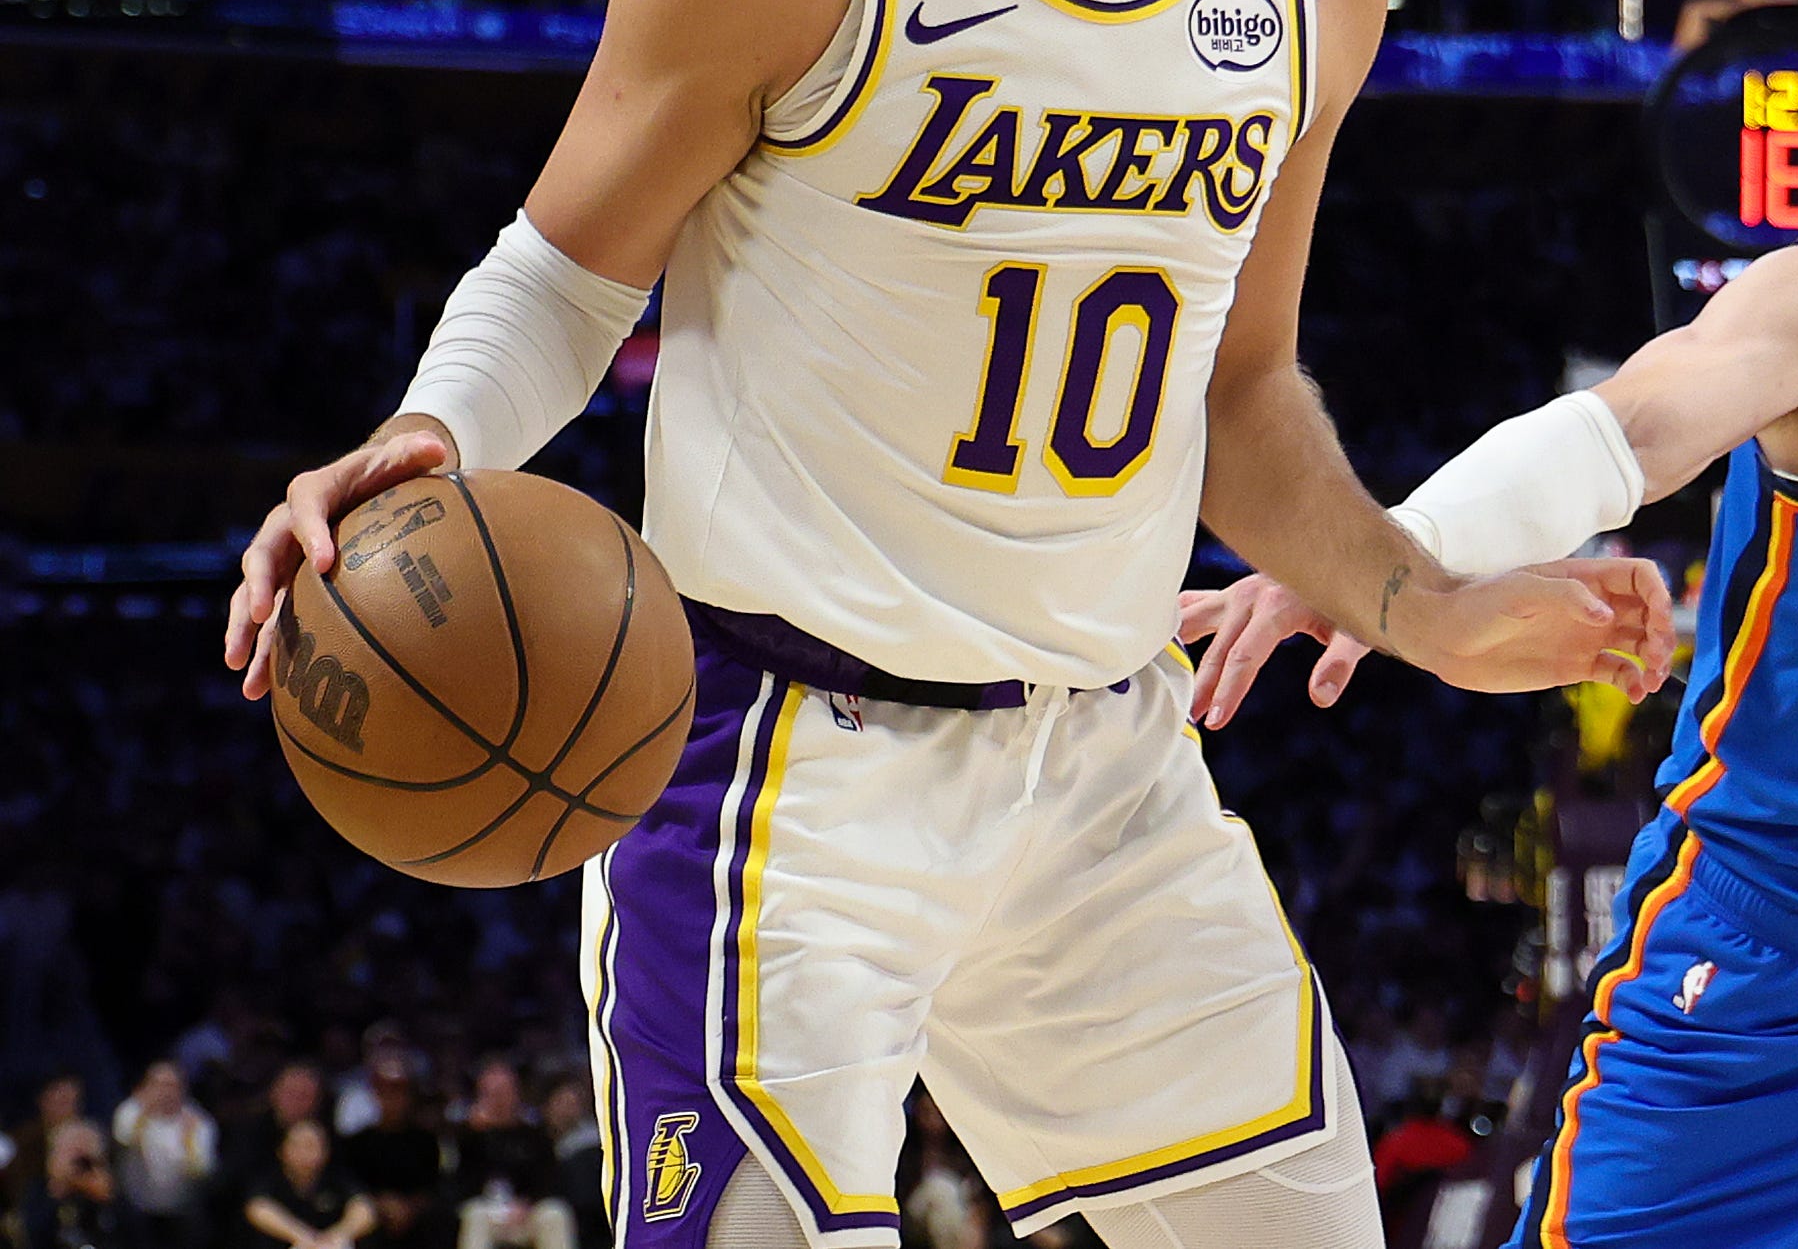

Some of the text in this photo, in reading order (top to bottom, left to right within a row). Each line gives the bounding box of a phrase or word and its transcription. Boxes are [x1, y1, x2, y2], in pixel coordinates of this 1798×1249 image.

[1197, 8, 1276, 47] bibigo
[1211, 38, 1245, 53] 비비고
[854, 72, 1277, 234] LAKERS
[941, 260, 1184, 498] 10
